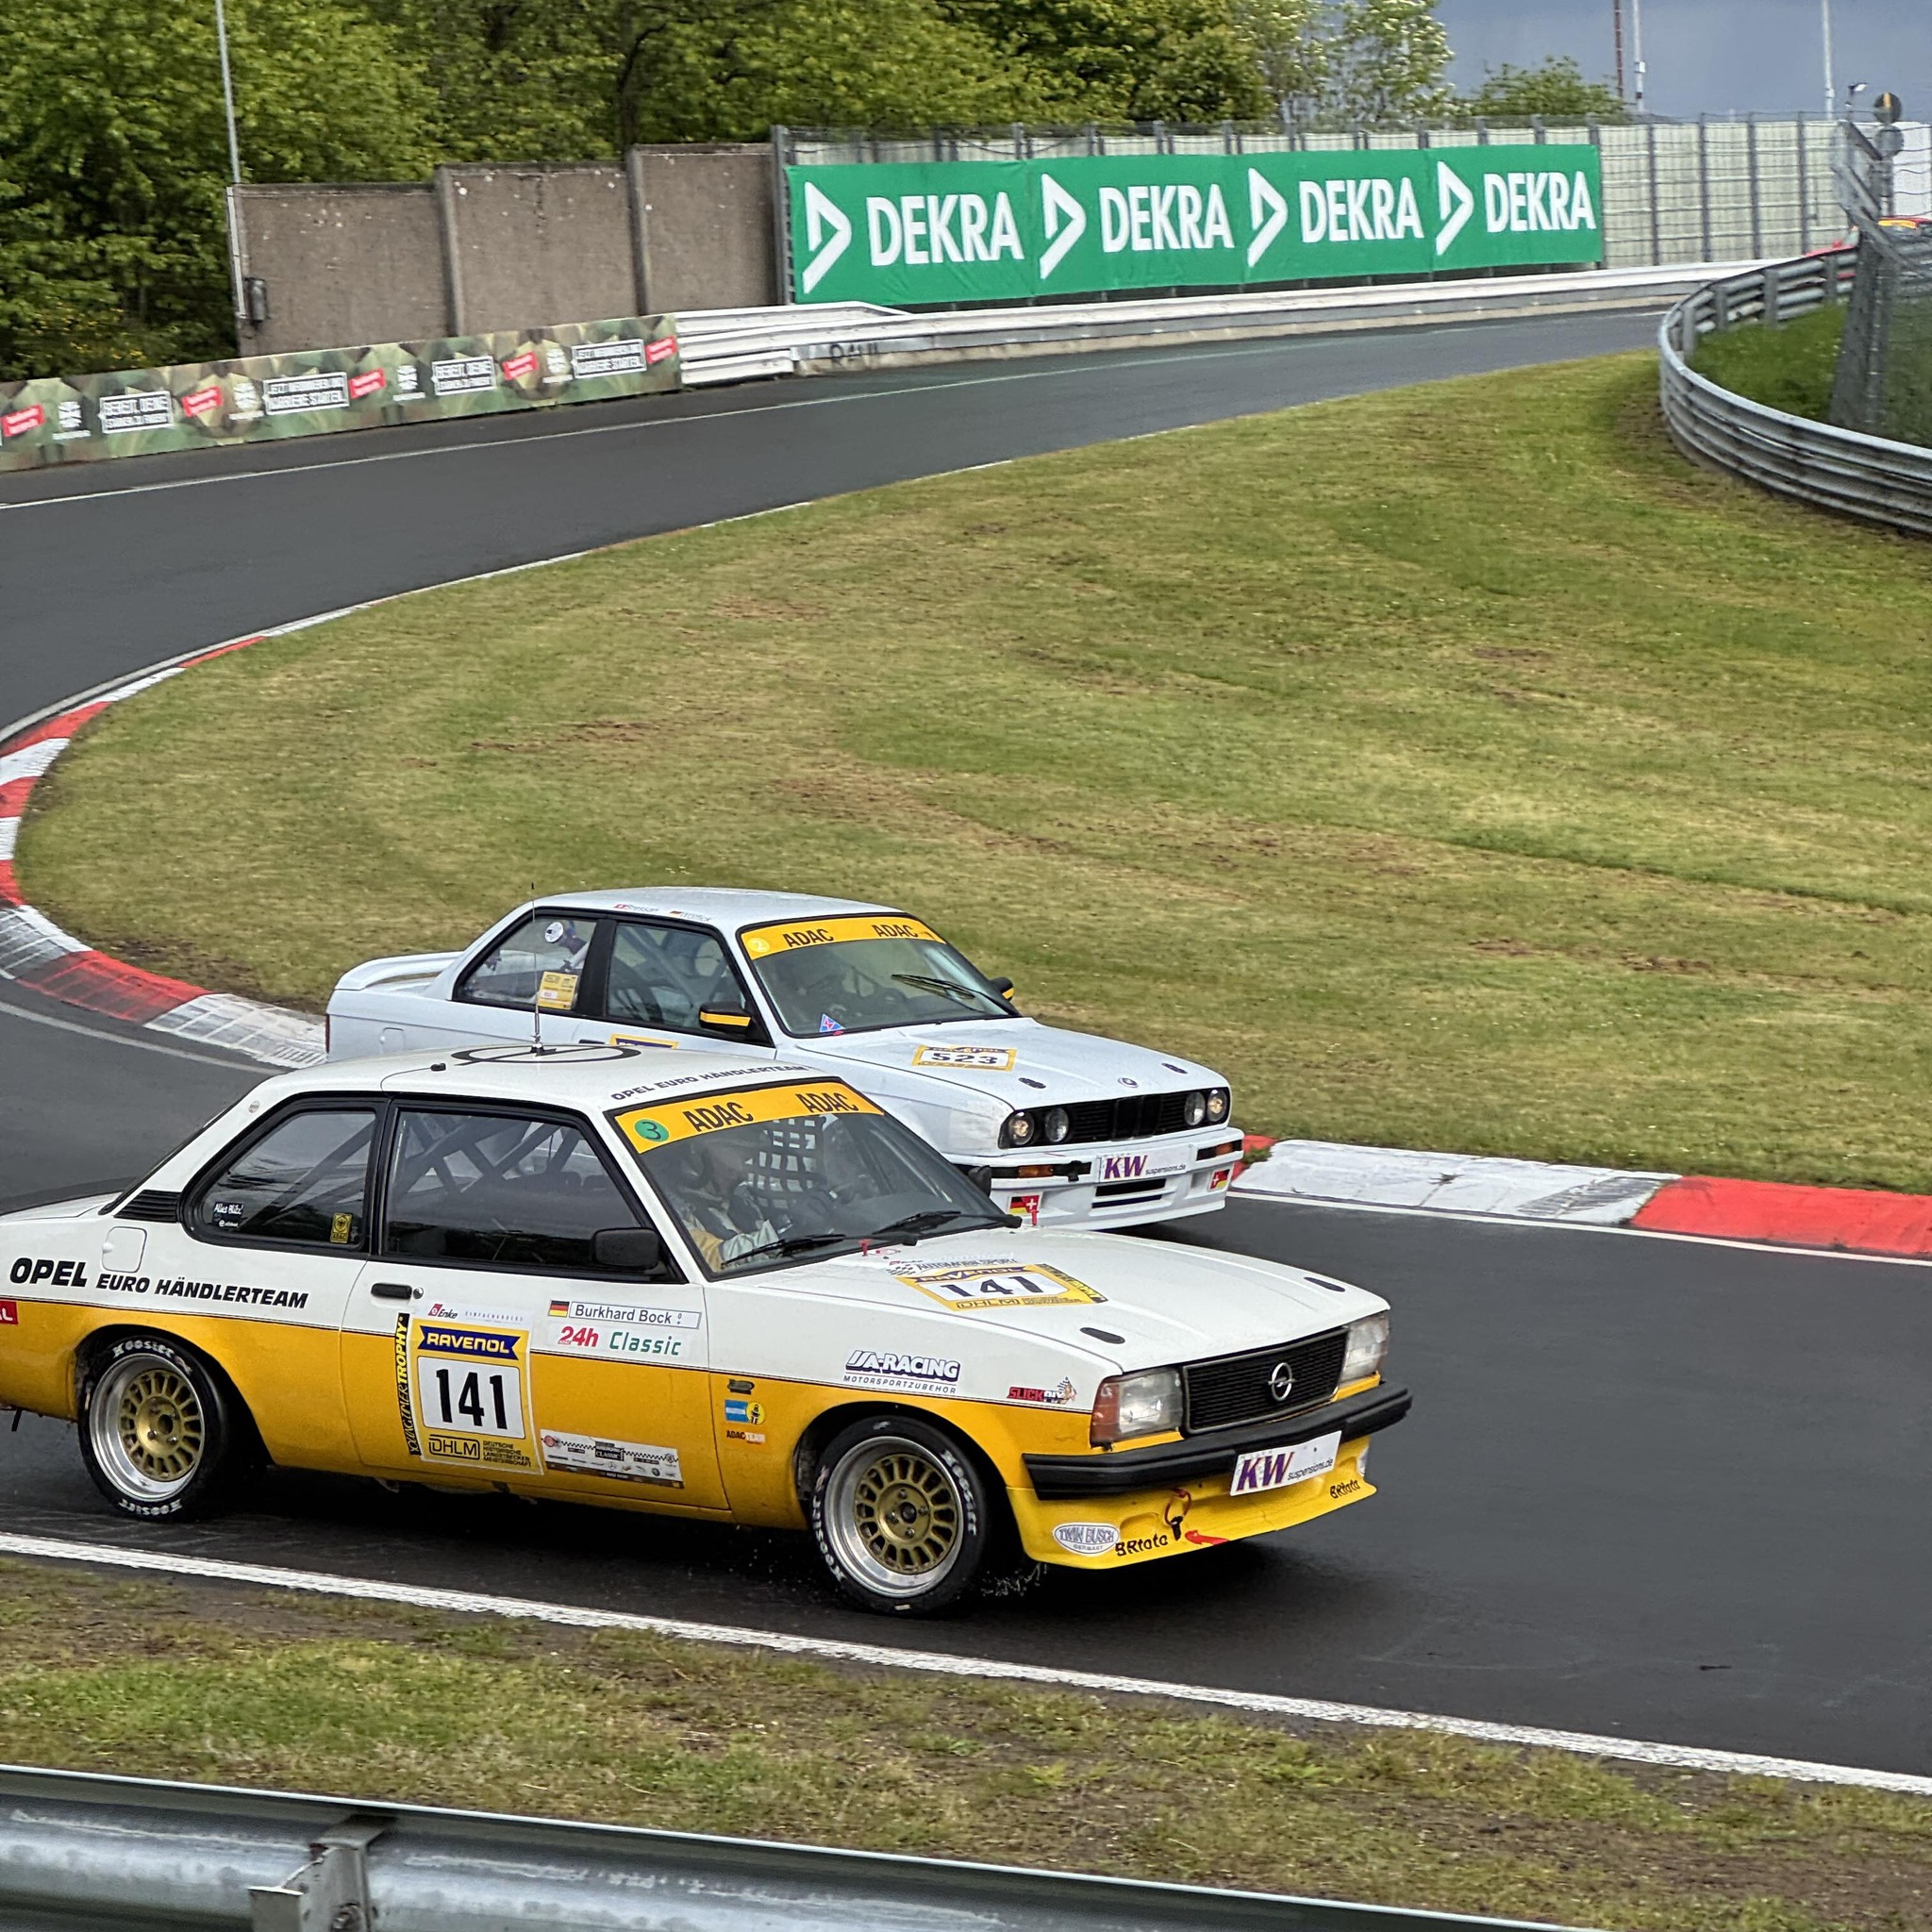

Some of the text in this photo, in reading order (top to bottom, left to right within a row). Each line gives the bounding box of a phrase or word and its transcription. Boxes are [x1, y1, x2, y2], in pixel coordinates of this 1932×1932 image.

[1299, 176, 1425, 243] DEKRA
[1484, 169, 1597, 232] DEKRA
[867, 191, 1025, 265] DEKRA
[1101, 182, 1235, 251] DEKRA
[782, 924, 919, 948] ADAC ADAC
[931, 1052, 999, 1065] 523
[610, 1085, 656, 1101] OPEL
[654, 1075, 699, 1090] EURO
[682, 1091, 859, 1132] ADAC ADAC
[641, 1121, 662, 1141] 3
[1104, 1154, 1148, 1179] KW
[9, 1257, 309, 1309] OPEL EURO HÄNDLERTEAM
[940, 1275, 1045, 1297] 141
[575, 1304, 673, 1324] Burkhard Bock
[426, 1332, 509, 1354] RAVENOL
[558, 1325, 682, 1356] 24h Classic
[436, 1369, 508, 1429] 141
[428, 1436, 478, 1458] DHLM
[726, 1430, 746, 1440] ADAC
[1236, 1451, 1295, 1491] KW
[1058, 1526, 1114, 1543] TWIN BUSCH
